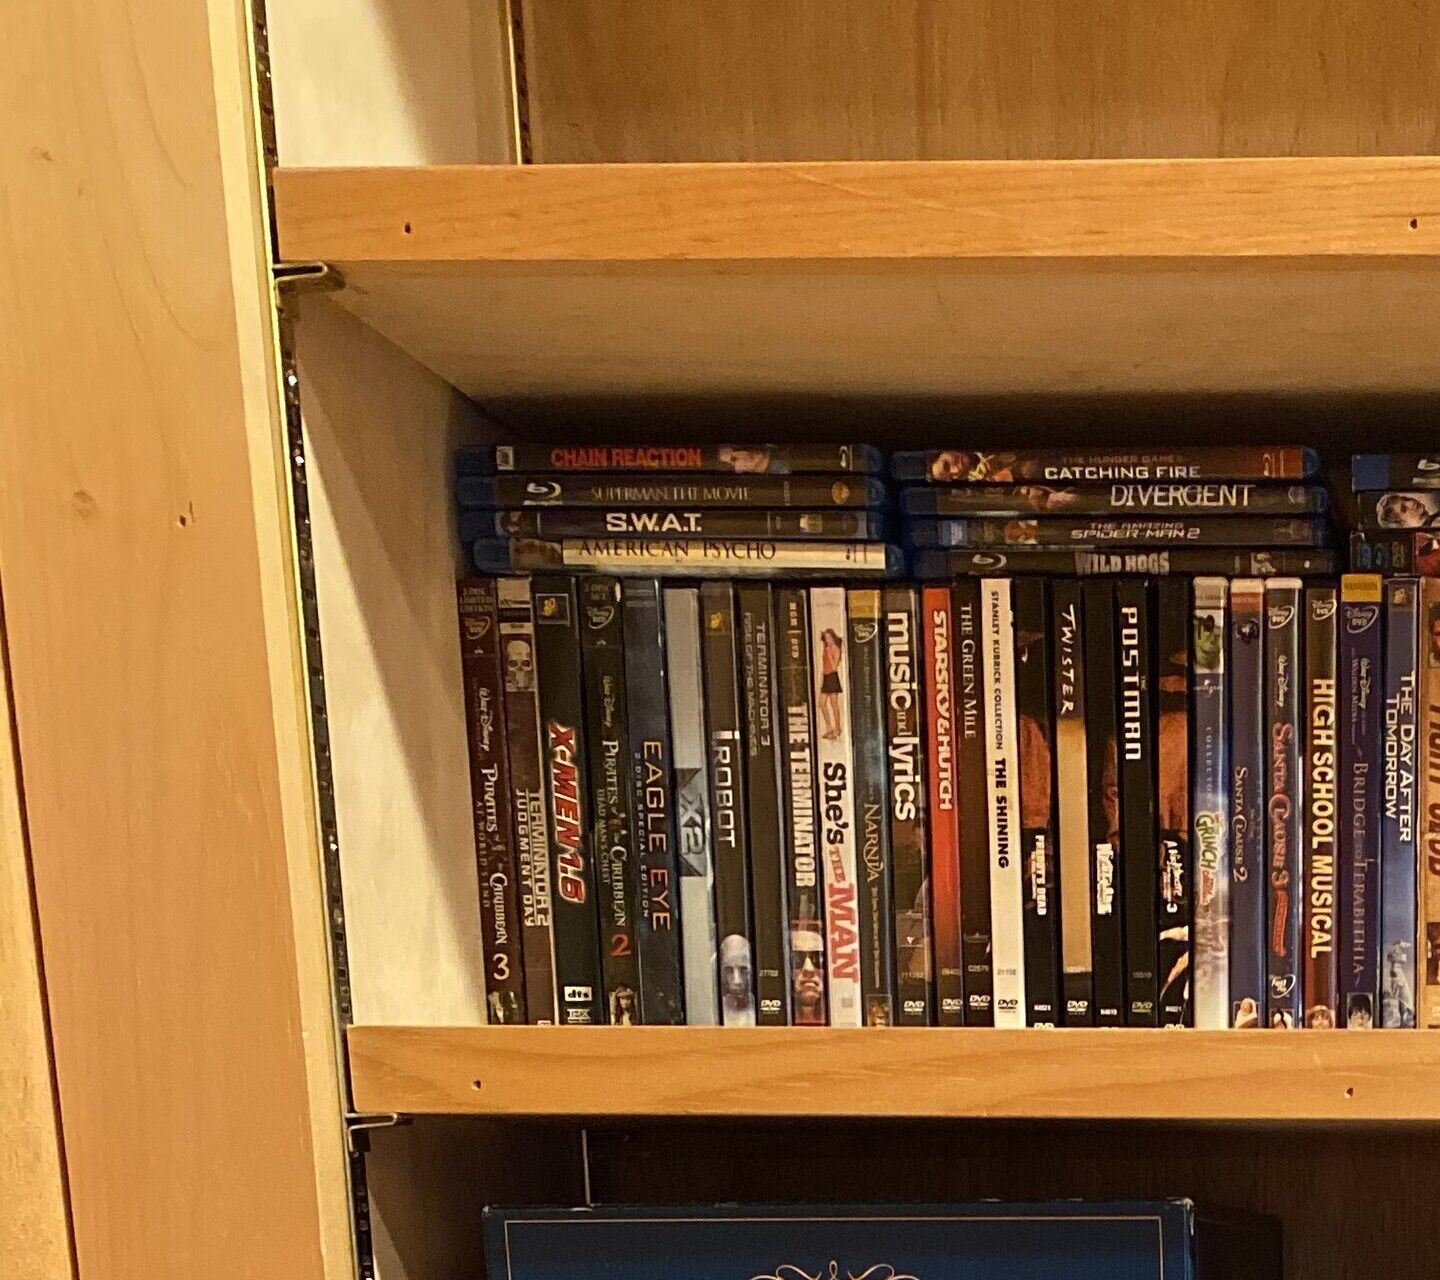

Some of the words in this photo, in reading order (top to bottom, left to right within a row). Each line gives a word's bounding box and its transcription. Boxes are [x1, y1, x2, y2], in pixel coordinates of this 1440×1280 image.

[551, 447, 607, 468] CHAIN
[612, 447, 702, 468] REACTION
[1045, 466, 1149, 480] CATCHING
[1157, 465, 1201, 480] FIRE
[606, 512, 702, 533] S.W.A.T.
[1110, 485, 1255, 507] DIVERGENT
[580, 540, 688, 557] AMERICAN
[700, 540, 776, 561] PSYCHO
[960, 603, 974, 636] THE
[961, 639, 976, 694] GREEN
[1060, 604, 1076, 716] TWISTER
[1122, 606, 1141, 760] POSTMAN
[787, 704, 808, 745] THE
[963, 699, 978, 739] MILE
[1312, 679, 1335, 746] HIGH
[1400, 670, 1415, 721] THE
[994, 758, 1006, 789] THE
[1385, 693, 1399, 818] TOMORROW
[1399, 725, 1414, 771] DAY
[641, 741, 666, 852] EAGLE
[789, 747, 815, 887] TERMINATOR
[823, 761, 849, 845] She's
[1311, 751, 1334, 849] SCHOOL
[1352, 762, 1368, 838] BRIDGE
[1399, 773, 1413, 841] AFTER
[862, 803, 884, 882] NARNIA
[995, 795, 1009, 868] SHINING
[648, 868, 671, 931] EYE
[828, 883, 859, 983] MAN
[1310, 855, 1332, 958] MUSICAL
